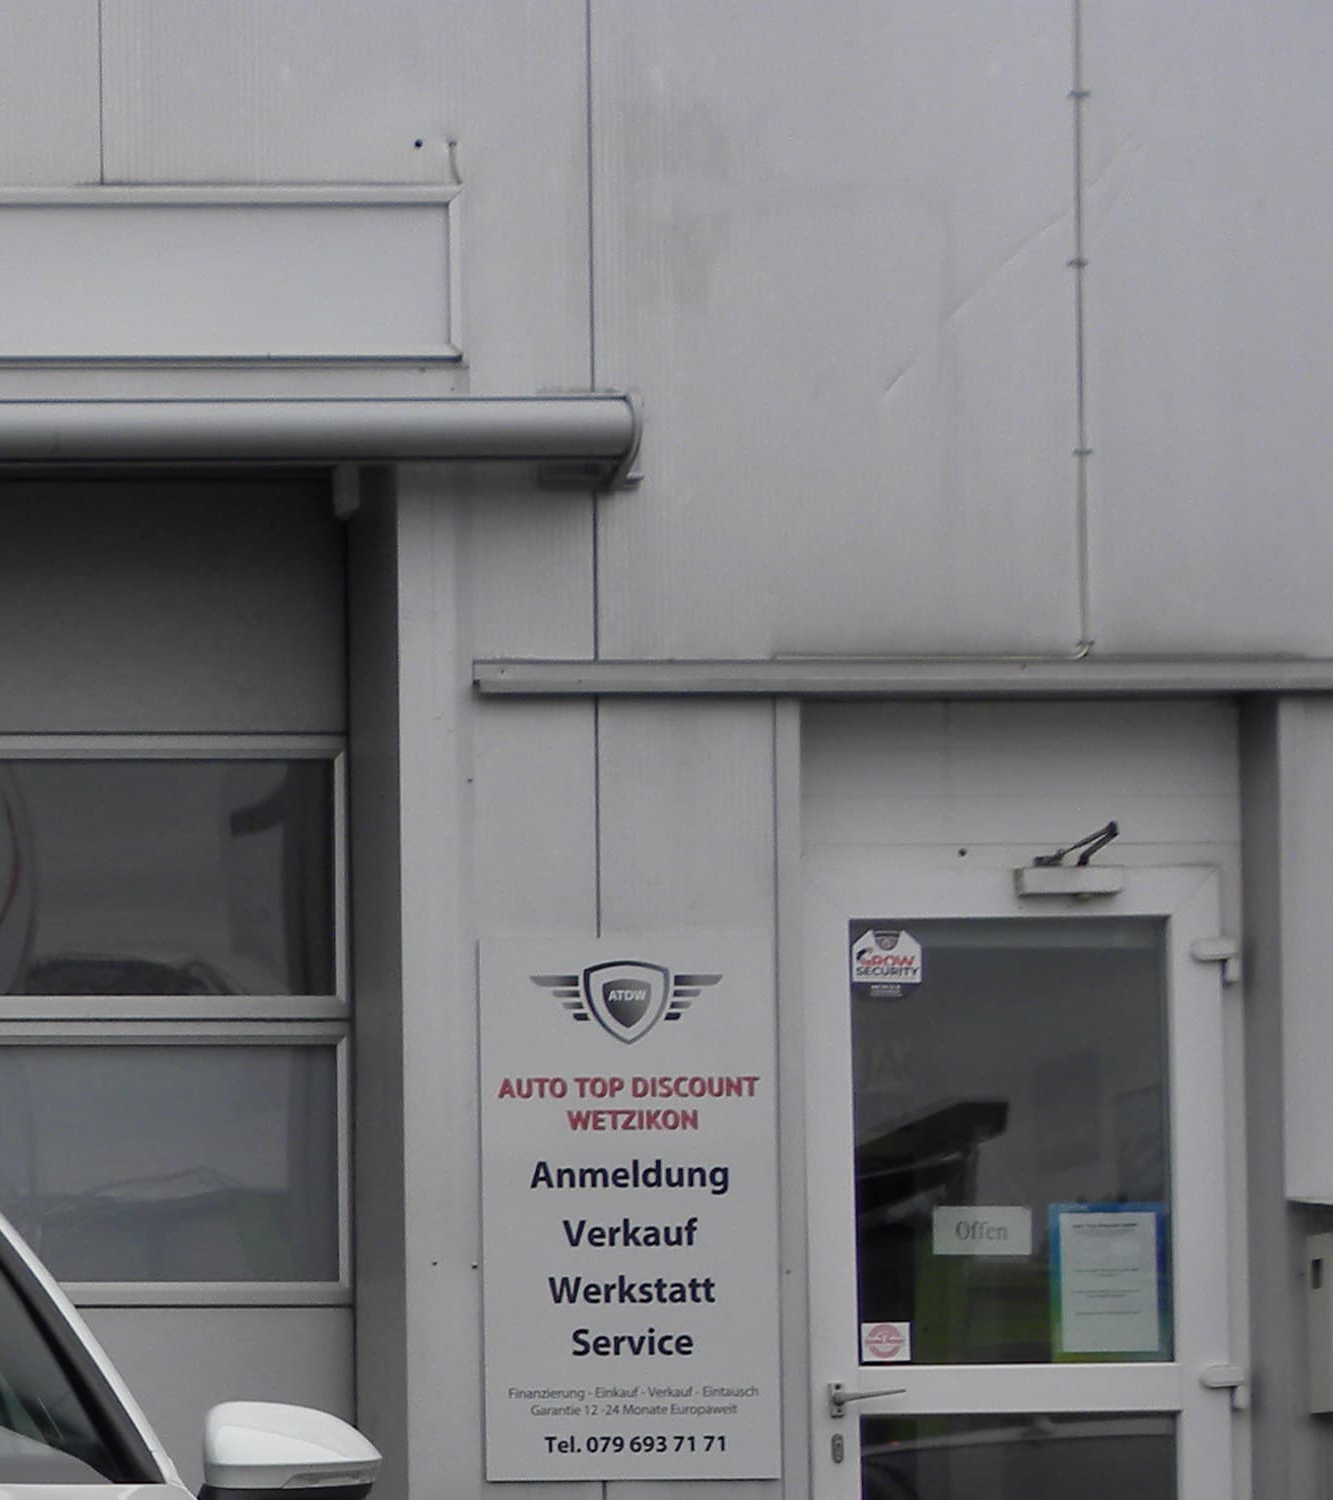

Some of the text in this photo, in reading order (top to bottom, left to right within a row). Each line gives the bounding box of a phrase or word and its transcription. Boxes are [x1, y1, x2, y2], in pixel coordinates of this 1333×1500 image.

[856, 966, 919, 976] SECURITY
[608, 989, 647, 1001] ATDW
[498, 1075, 760, 1099] AUTO TOP DISCOUNT
[567, 1109, 699, 1131] WETZIKON
[530, 1159, 729, 1195] Anmeldung
[562, 1217, 699, 1247] Verkauf
[955, 1220, 1008, 1240] Offen
[548, 1275, 716, 1304] Werkstatt
[572, 1328, 694, 1356] Service
[508, 1386, 759, 1400] Finanzierung Einkauf Verkauf Eintausch
[531, 1405, 581, 1416] Garantie
[585, 1405, 598, 1415] 12
[623, 1404, 668, 1415] Monate
[670, 1404, 738, 1417] Europaweit
[545, 1436, 726, 1453] Tel. 079 693 71 71
